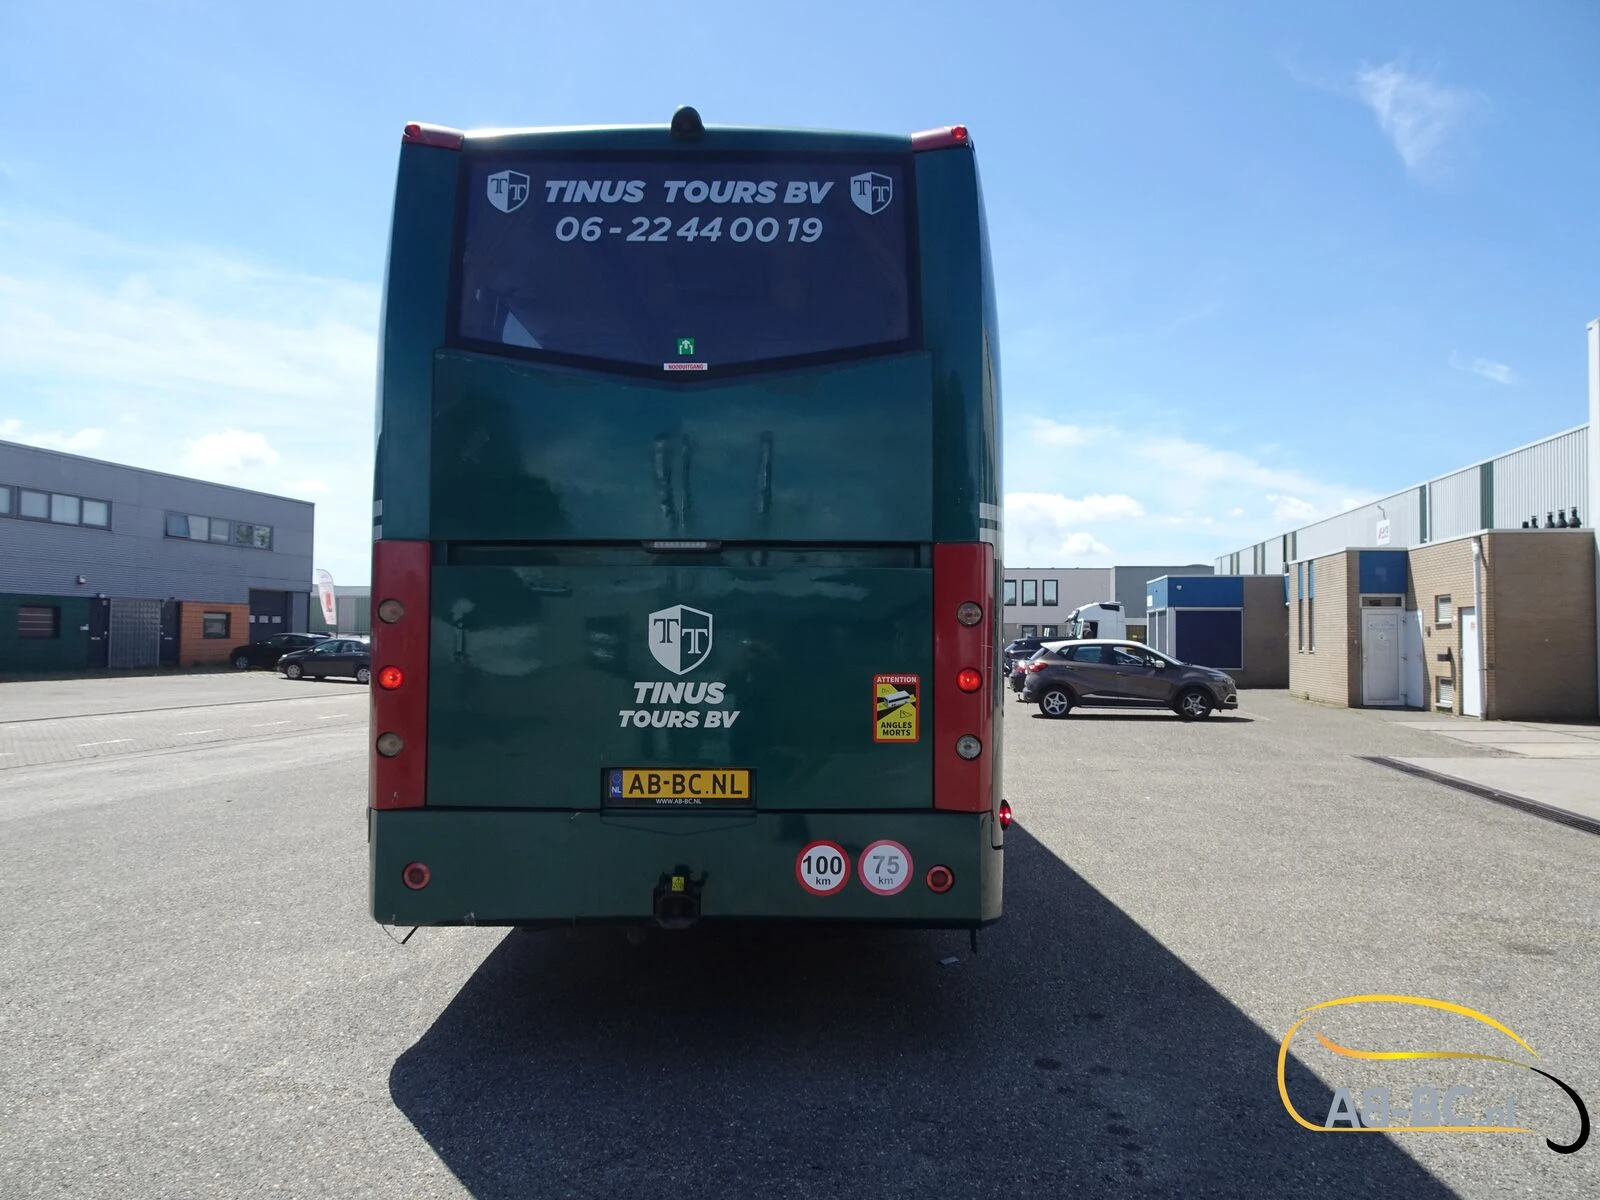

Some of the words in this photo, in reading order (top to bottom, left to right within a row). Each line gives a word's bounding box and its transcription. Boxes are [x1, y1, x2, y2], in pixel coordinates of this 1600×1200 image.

[545, 180, 646, 203] TINUS
[663, 180, 778, 204] TOURS
[783, 181, 834, 204] BV
[633, 682, 726, 705] TINUS
[619, 710, 700, 728] TOURS
[703, 710, 741, 729] BV
[880, 721, 913, 729] ANGLES
[882, 729, 911, 737] MORTS
[611, 786, 622, 794] NL
[628, 773, 743, 795] AB-BC.NL
[802, 855, 843, 875] 100
[872, 855, 900, 875] 75
[815, 876, 831, 886] km
[878, 876, 894, 886] km
